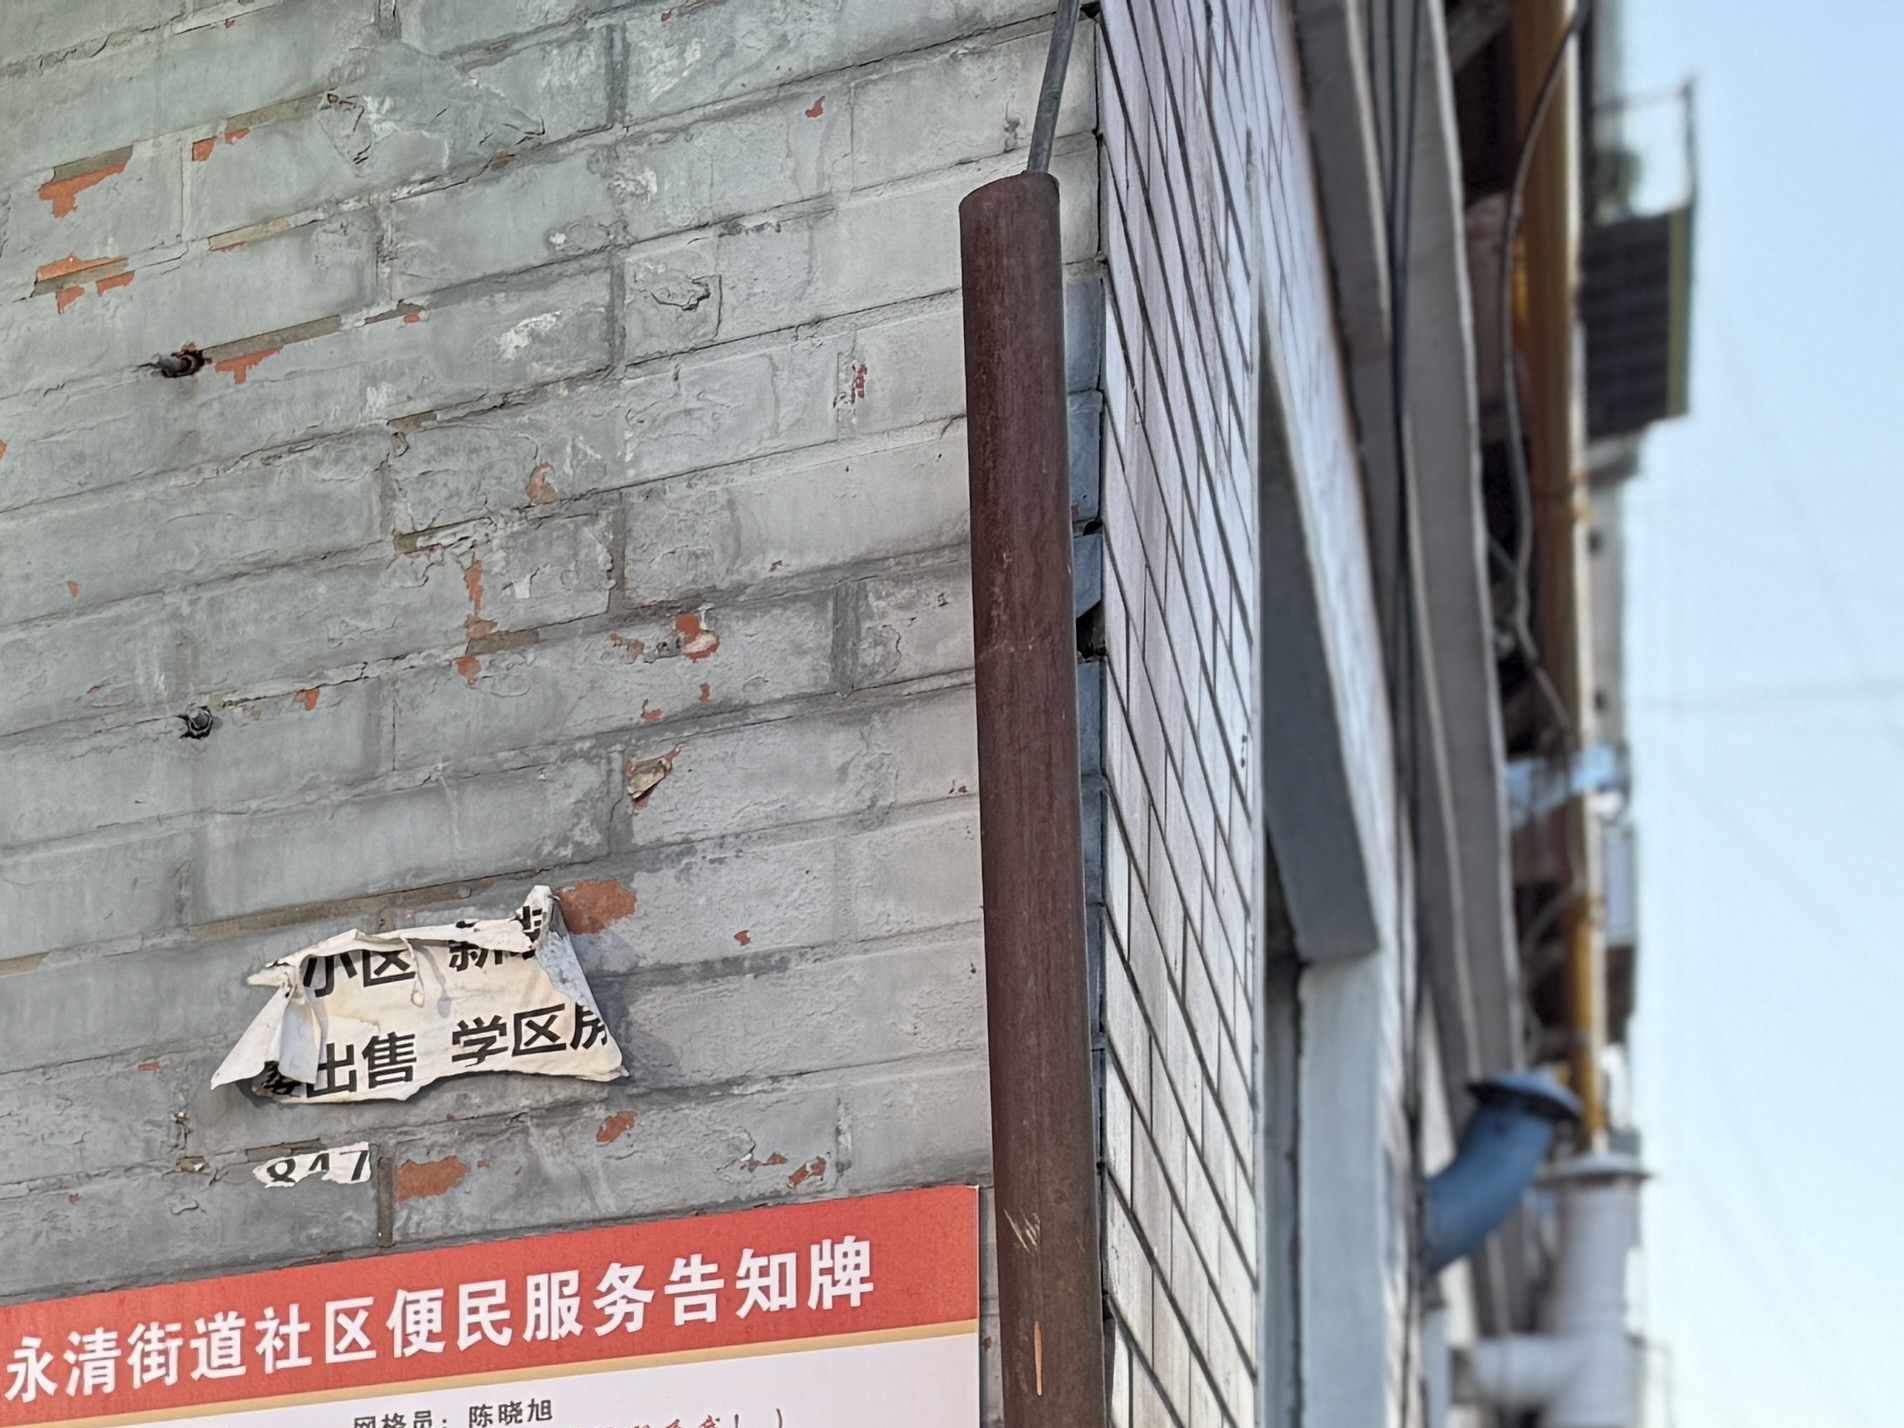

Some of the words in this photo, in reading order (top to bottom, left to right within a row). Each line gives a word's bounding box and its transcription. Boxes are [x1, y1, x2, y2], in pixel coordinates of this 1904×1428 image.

[3, 1234, 876, 1404] 永清街道社区便民服务告知牌
